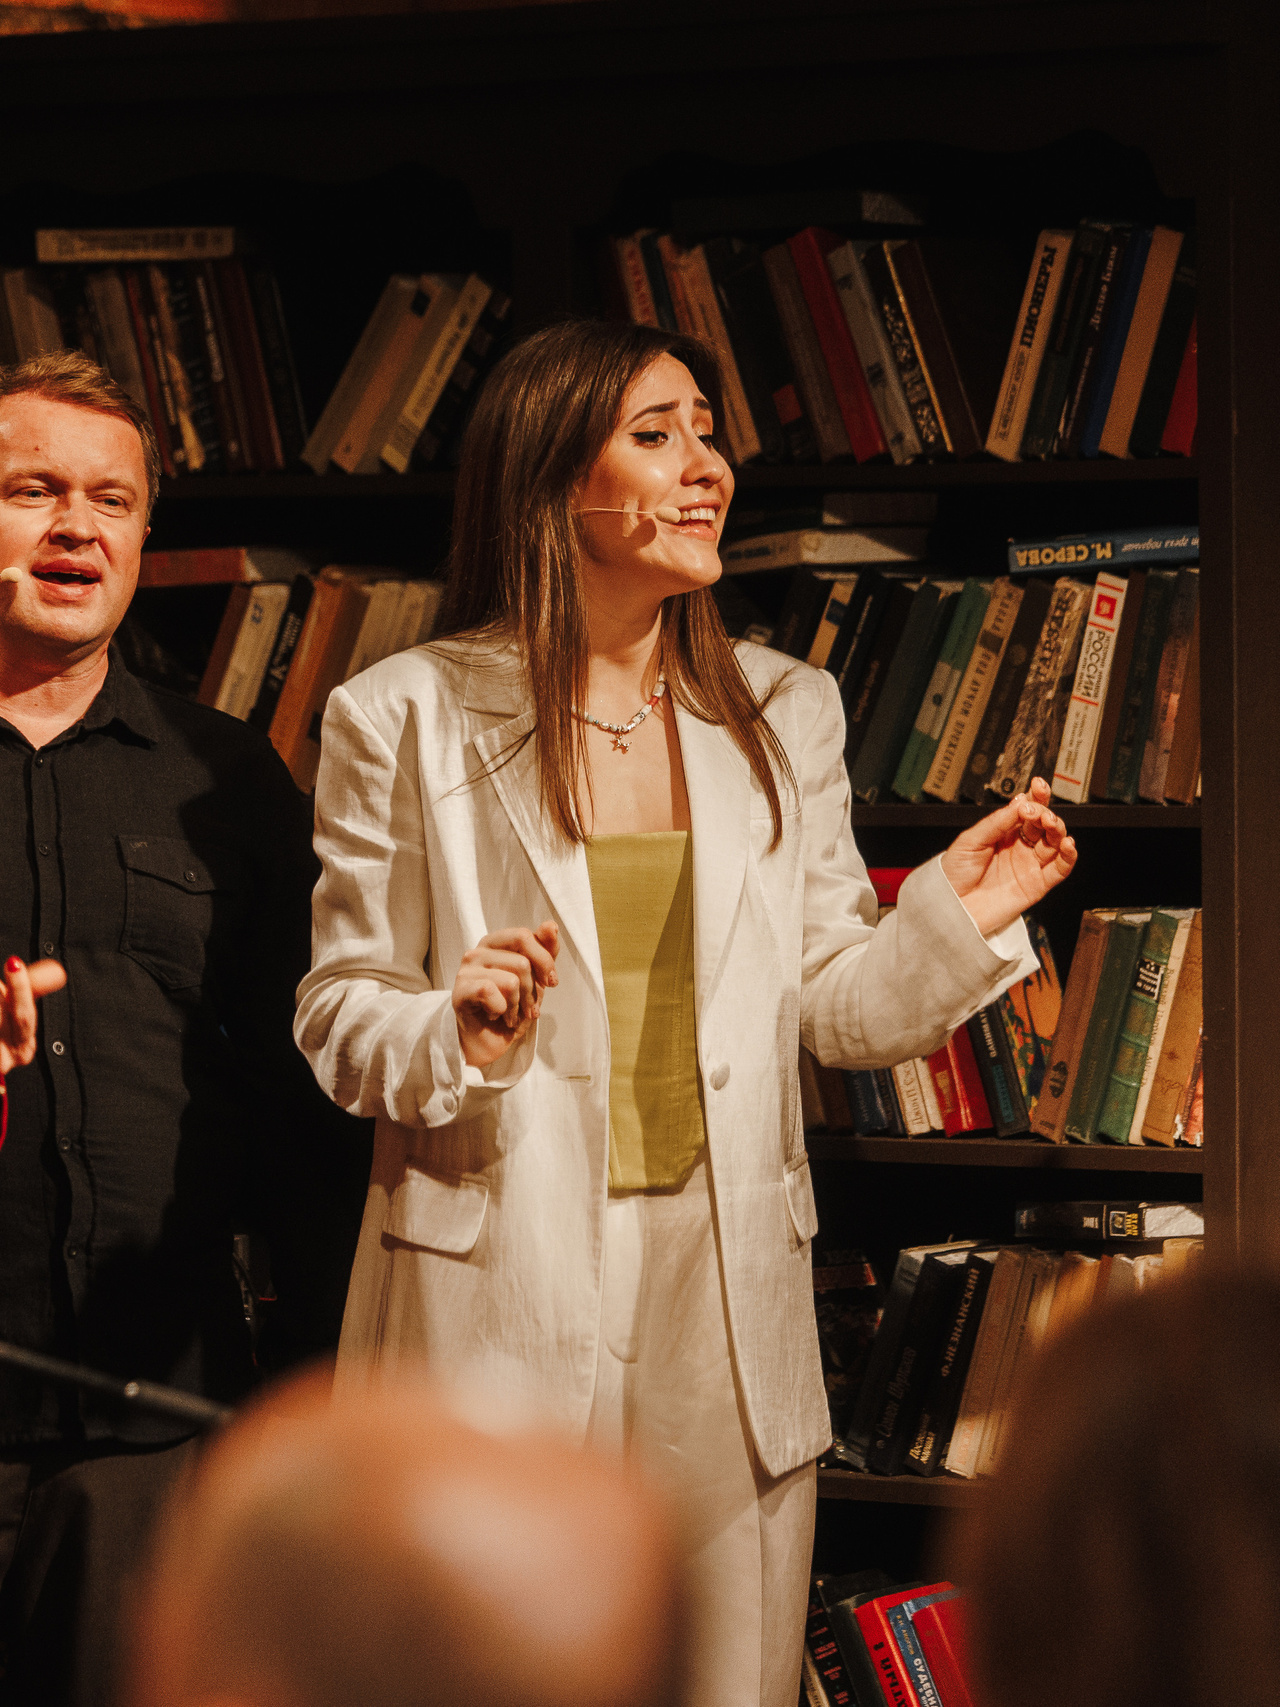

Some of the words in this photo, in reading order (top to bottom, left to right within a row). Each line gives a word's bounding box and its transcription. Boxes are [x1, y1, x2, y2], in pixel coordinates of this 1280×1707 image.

[1018, 245, 1057, 348] ПИОНЕРЫ
[1015, 544, 1089, 567] СЕРОВА
[1080, 628, 1107, 698] РОССИИ
[913, 1658, 939, 1707] СУДЕБН
